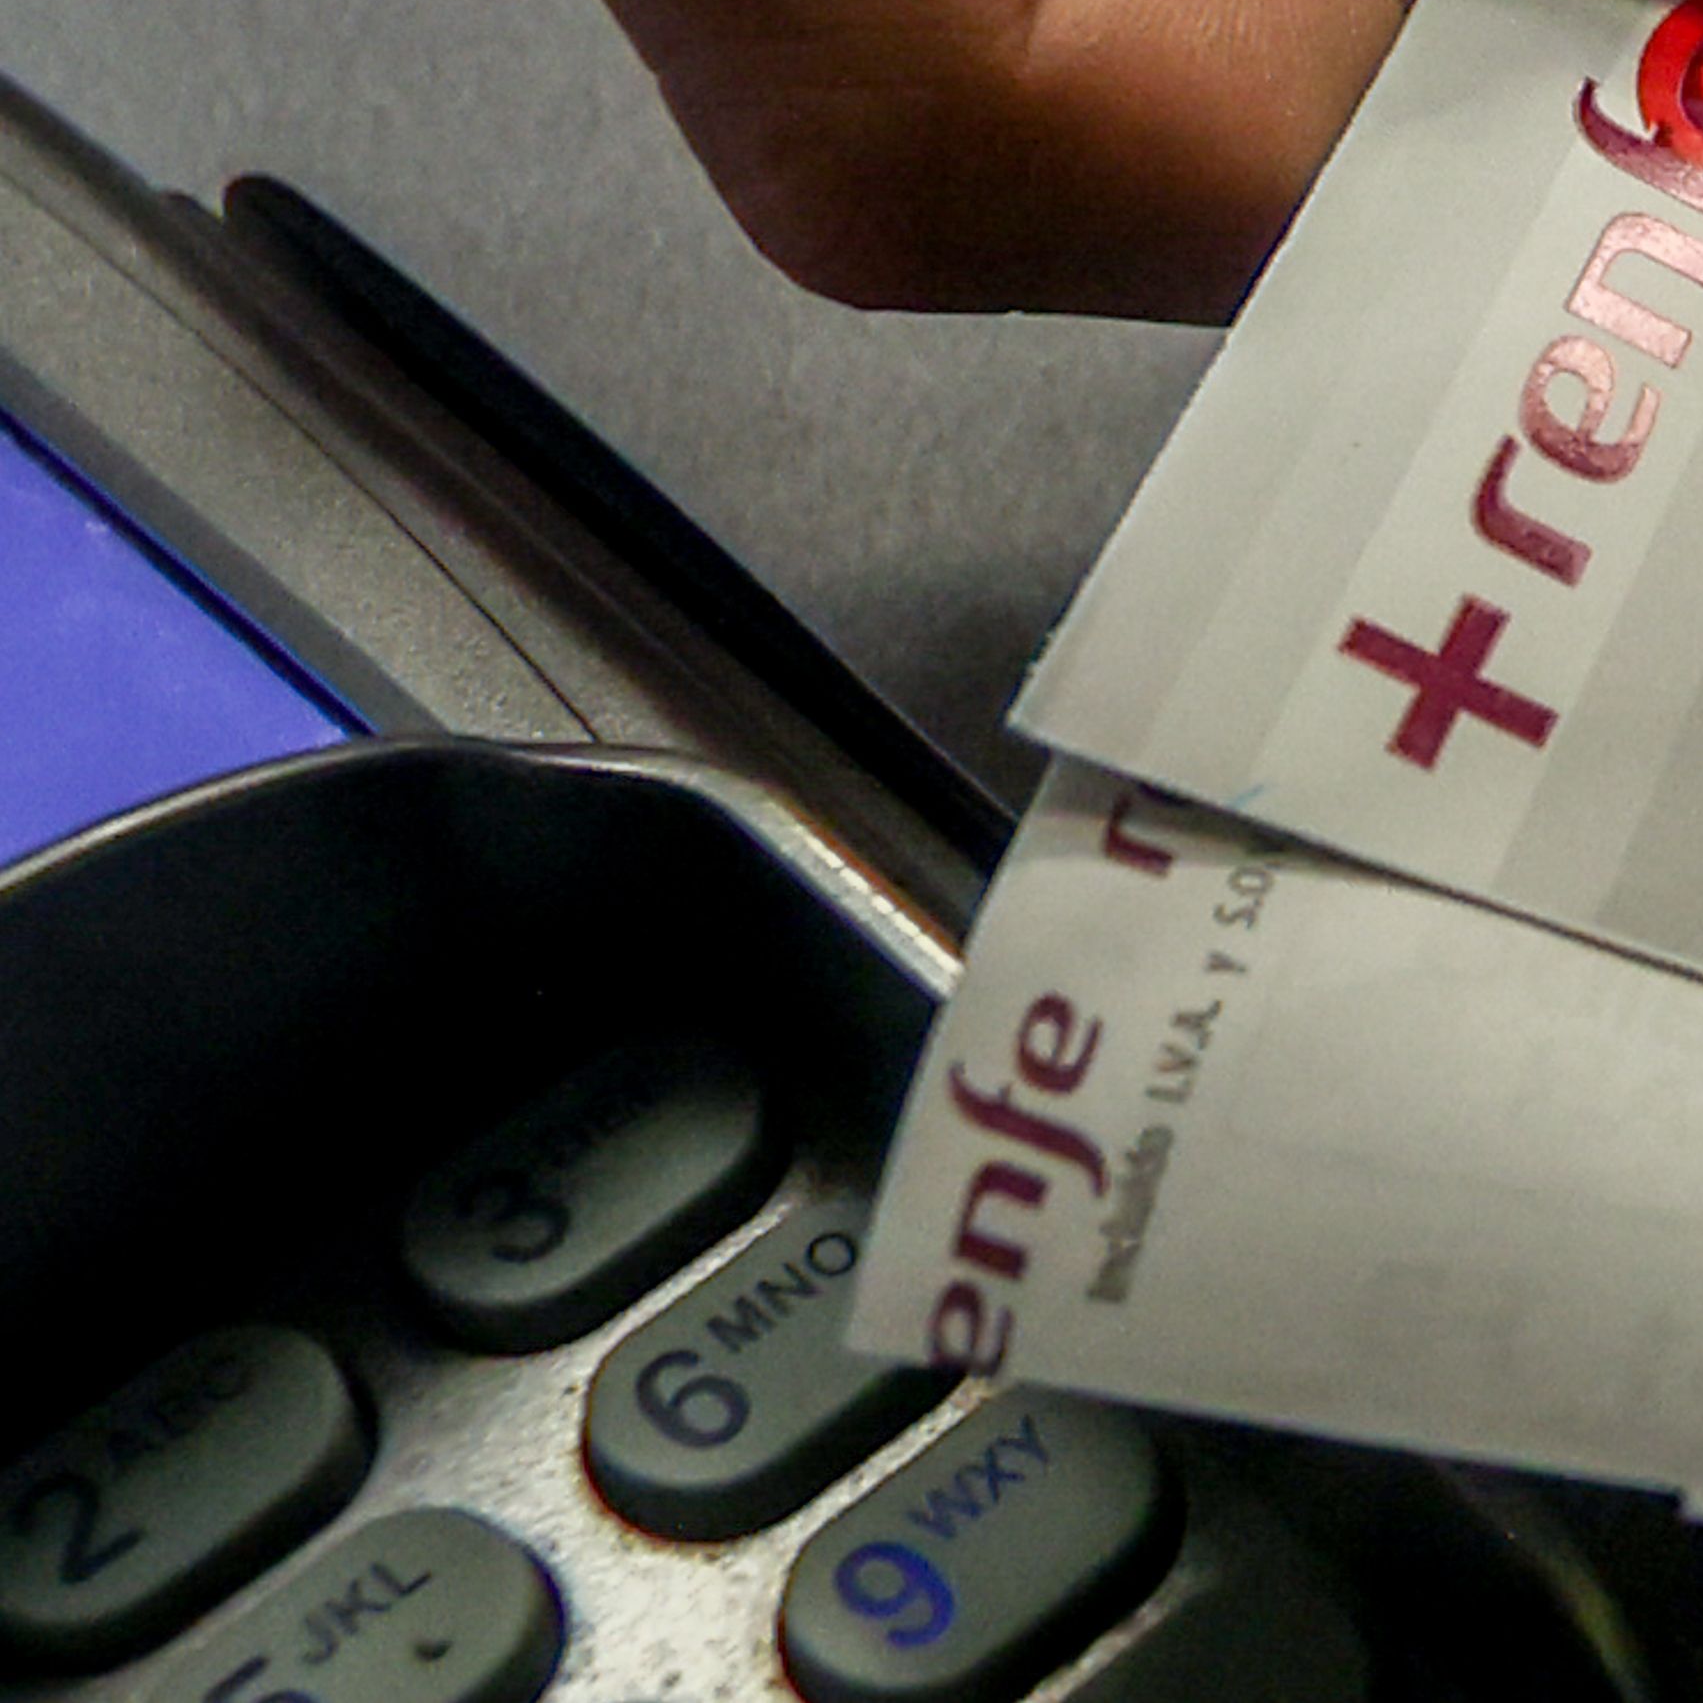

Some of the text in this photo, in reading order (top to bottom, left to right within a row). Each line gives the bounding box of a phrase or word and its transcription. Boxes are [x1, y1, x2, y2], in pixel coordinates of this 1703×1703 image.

[455, 1167, 571, 1265] 3
[633, 1229, 862, 1452] 6 MNO
[4, 1469, 142, 1587] 2
[831, 1413, 1056, 1653] 9 WXY
[300, 1561, 434, 1666] JKL
